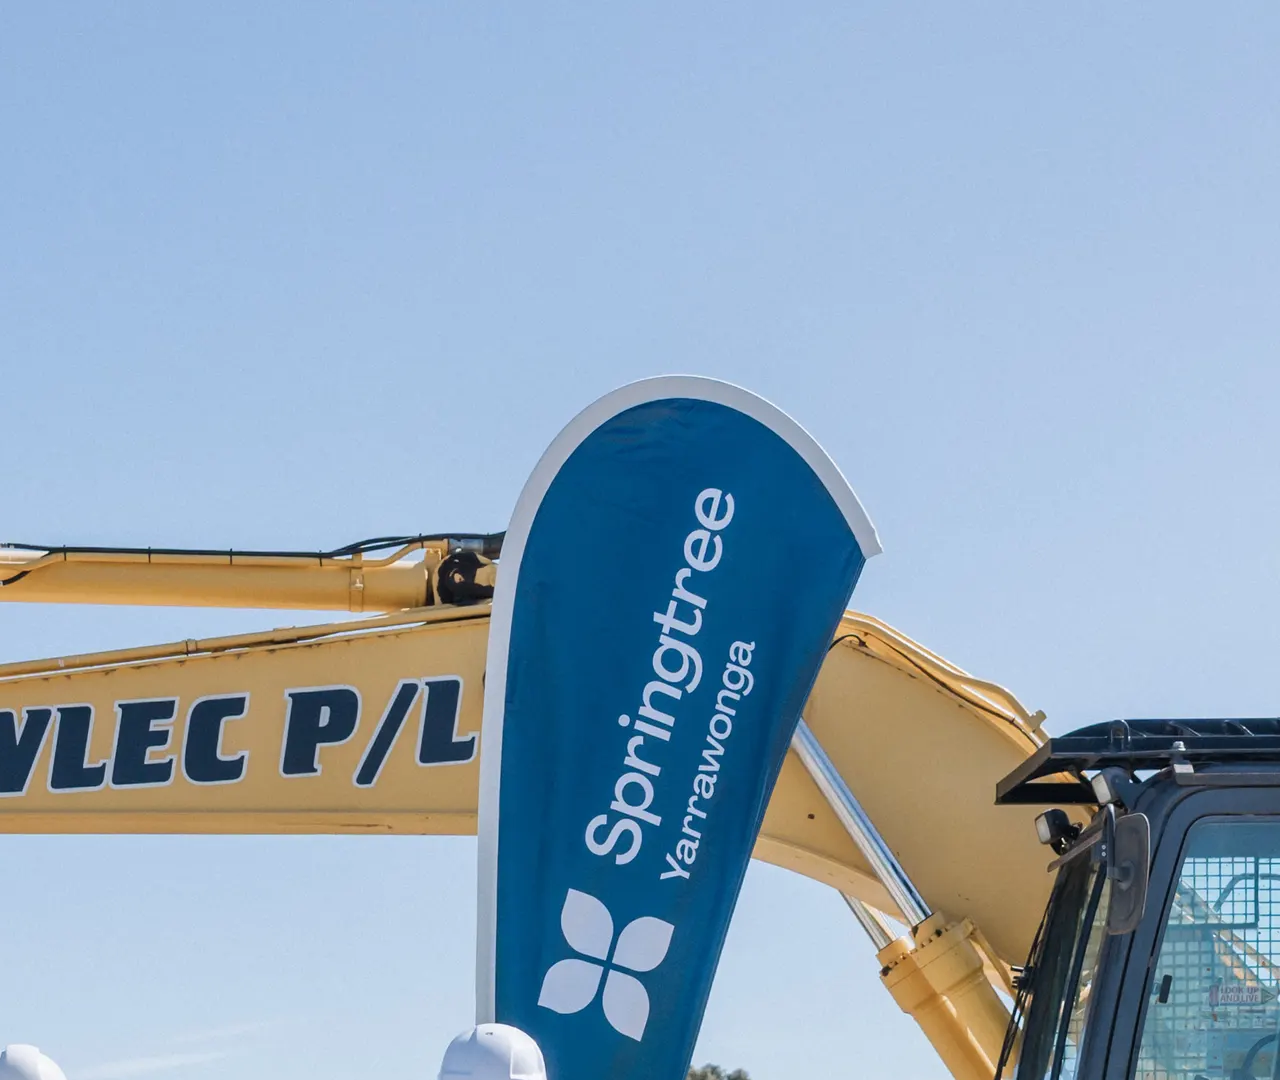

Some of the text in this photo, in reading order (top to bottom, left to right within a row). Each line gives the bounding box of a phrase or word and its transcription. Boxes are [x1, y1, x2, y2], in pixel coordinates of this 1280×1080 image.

[279, 675, 478, 788] P/L
[585, 487, 735, 865] Springtree
[659, 640, 756, 880] Yarrawonga
[1220, 994, 1259, 1003] AND LIVE
[1247, 986, 1259, 994] UP
